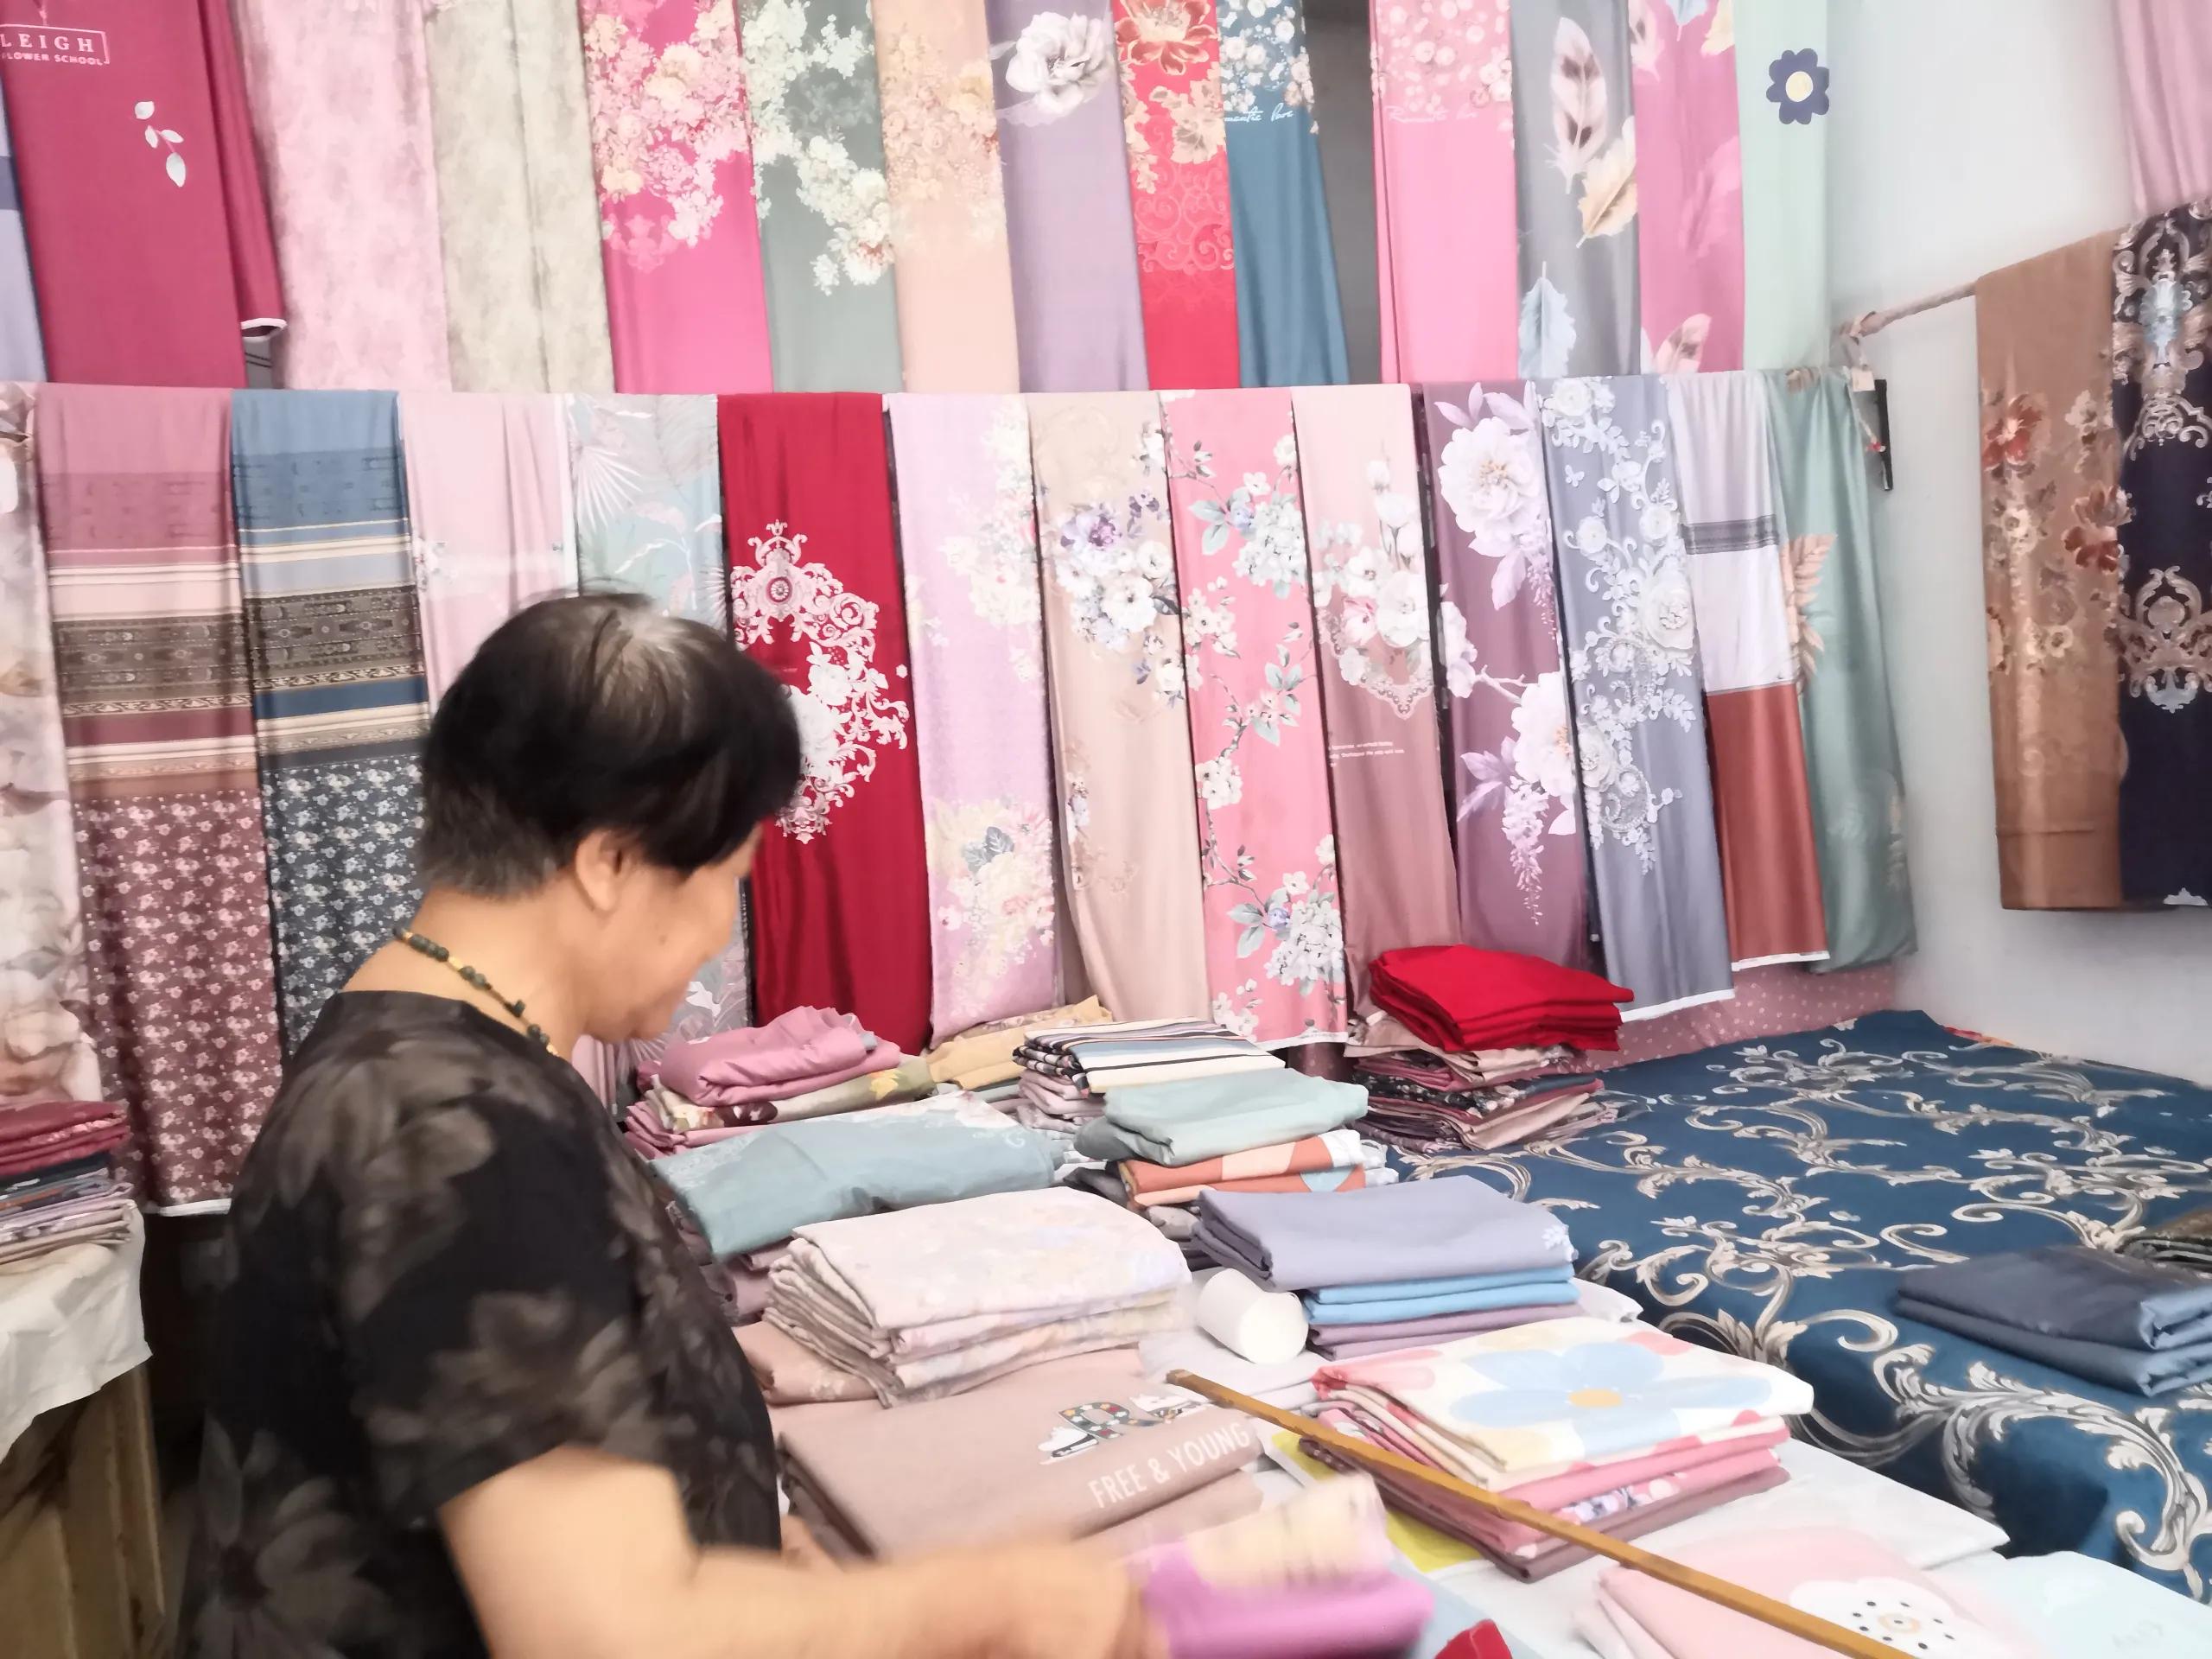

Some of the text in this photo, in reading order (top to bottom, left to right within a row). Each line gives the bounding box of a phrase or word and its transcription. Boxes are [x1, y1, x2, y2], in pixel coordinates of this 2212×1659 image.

[0, 33, 94, 53] LEIGH
[54, 54, 103, 66] SCHOOL
[1087, 1422, 1250, 1509] FREE & YOUNG
